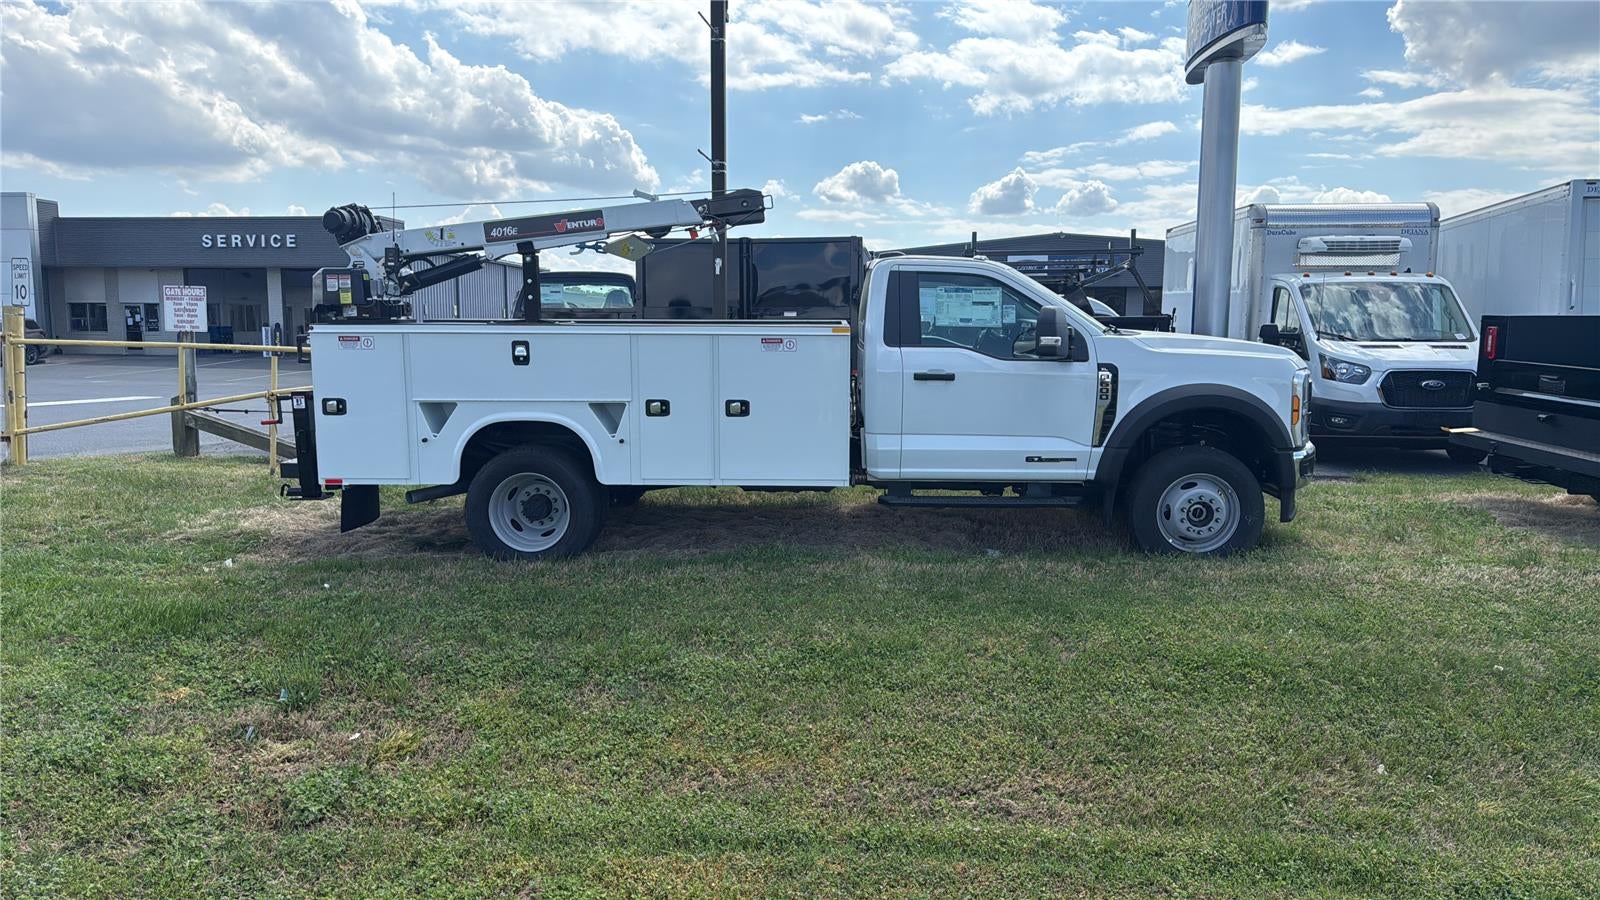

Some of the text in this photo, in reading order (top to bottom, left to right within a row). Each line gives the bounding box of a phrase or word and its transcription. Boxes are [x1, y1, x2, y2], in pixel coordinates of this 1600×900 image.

[489, 226, 519, 238] 4016E
[554, 217, 605, 233] VENTURO
[201, 233, 297, 248] SERVICE
[15, 284, 27, 300] 10
[165, 288, 205, 296] GATE HOURS
